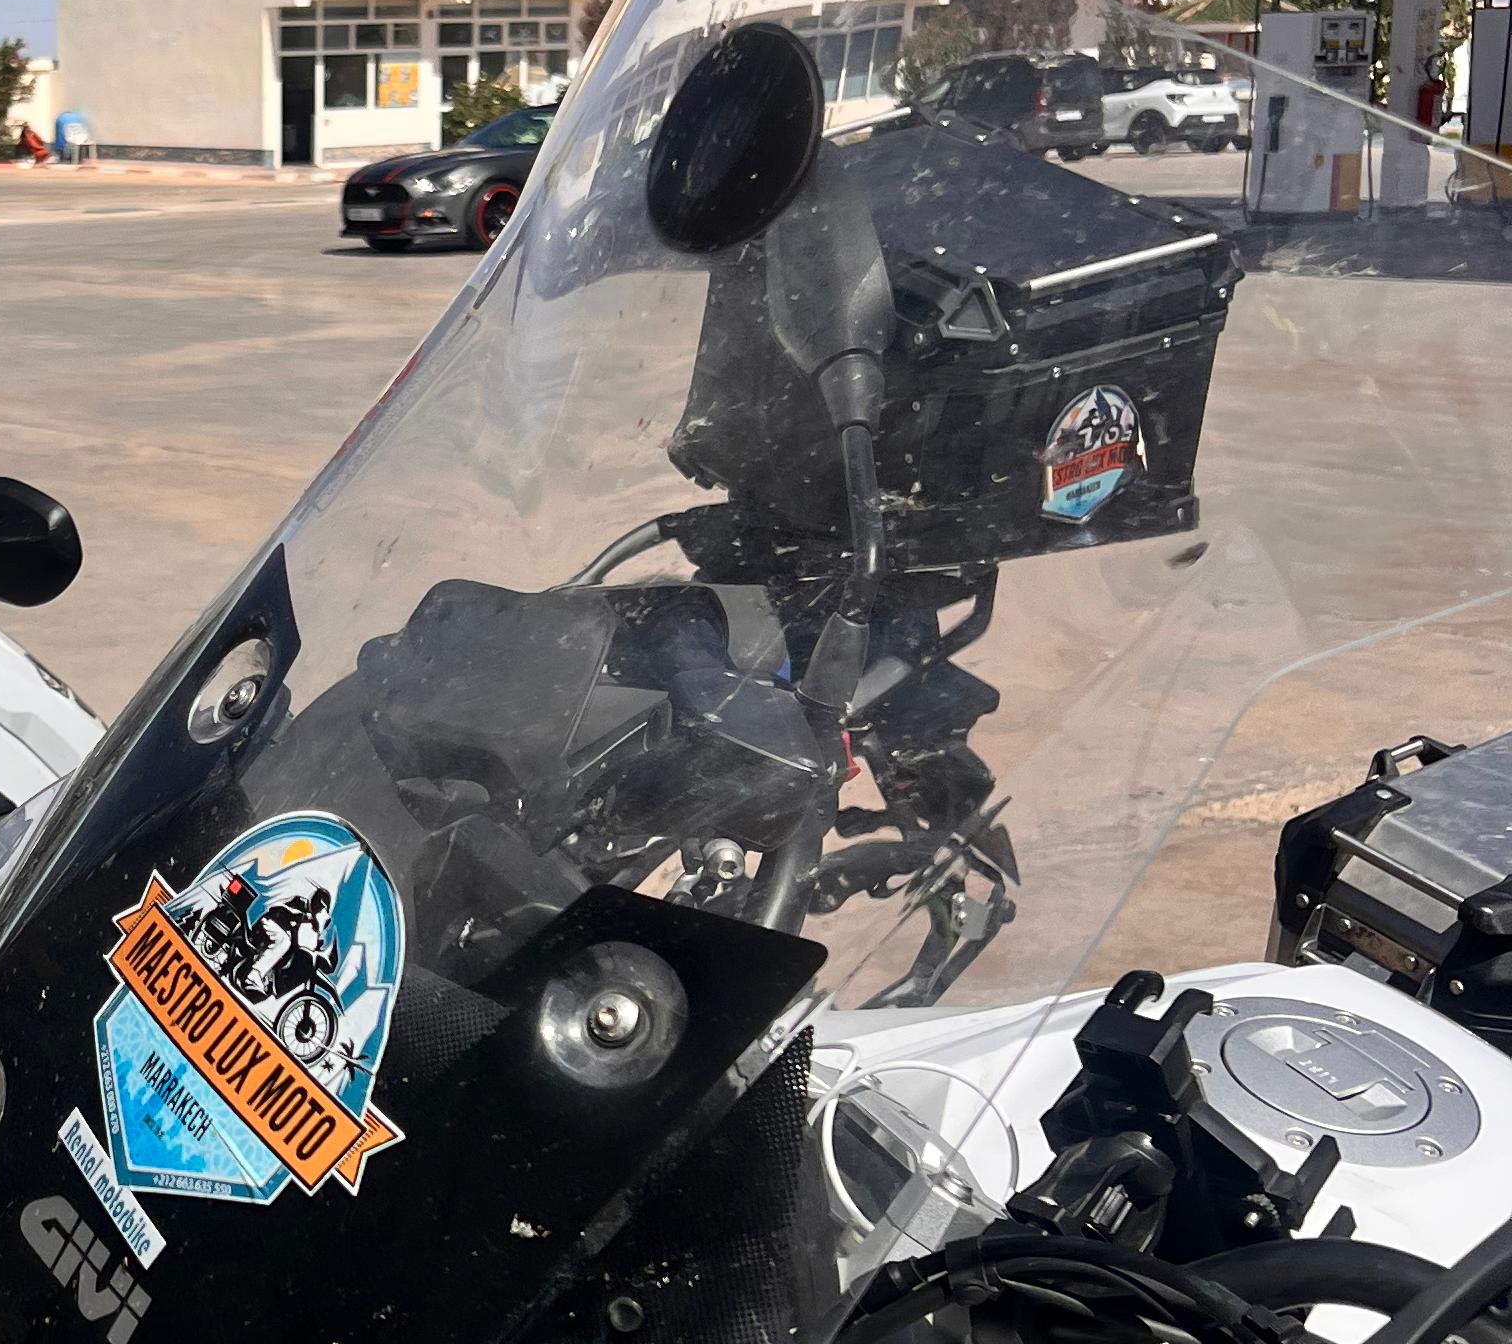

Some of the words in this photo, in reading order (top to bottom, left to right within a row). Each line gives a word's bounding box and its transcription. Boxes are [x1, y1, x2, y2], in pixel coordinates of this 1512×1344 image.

[124, 920, 223, 1044] MAESTRO
[202, 1016, 271, 1095] LUX
[246, 1063, 337, 1162] MOTO
[139, 1050, 213, 1141] MARRAKECH
[1298, 1059, 1338, 1084] LIFT
[65, 1120, 102, 1175] Rental
[95, 1167, 151, 1256] motorbike
